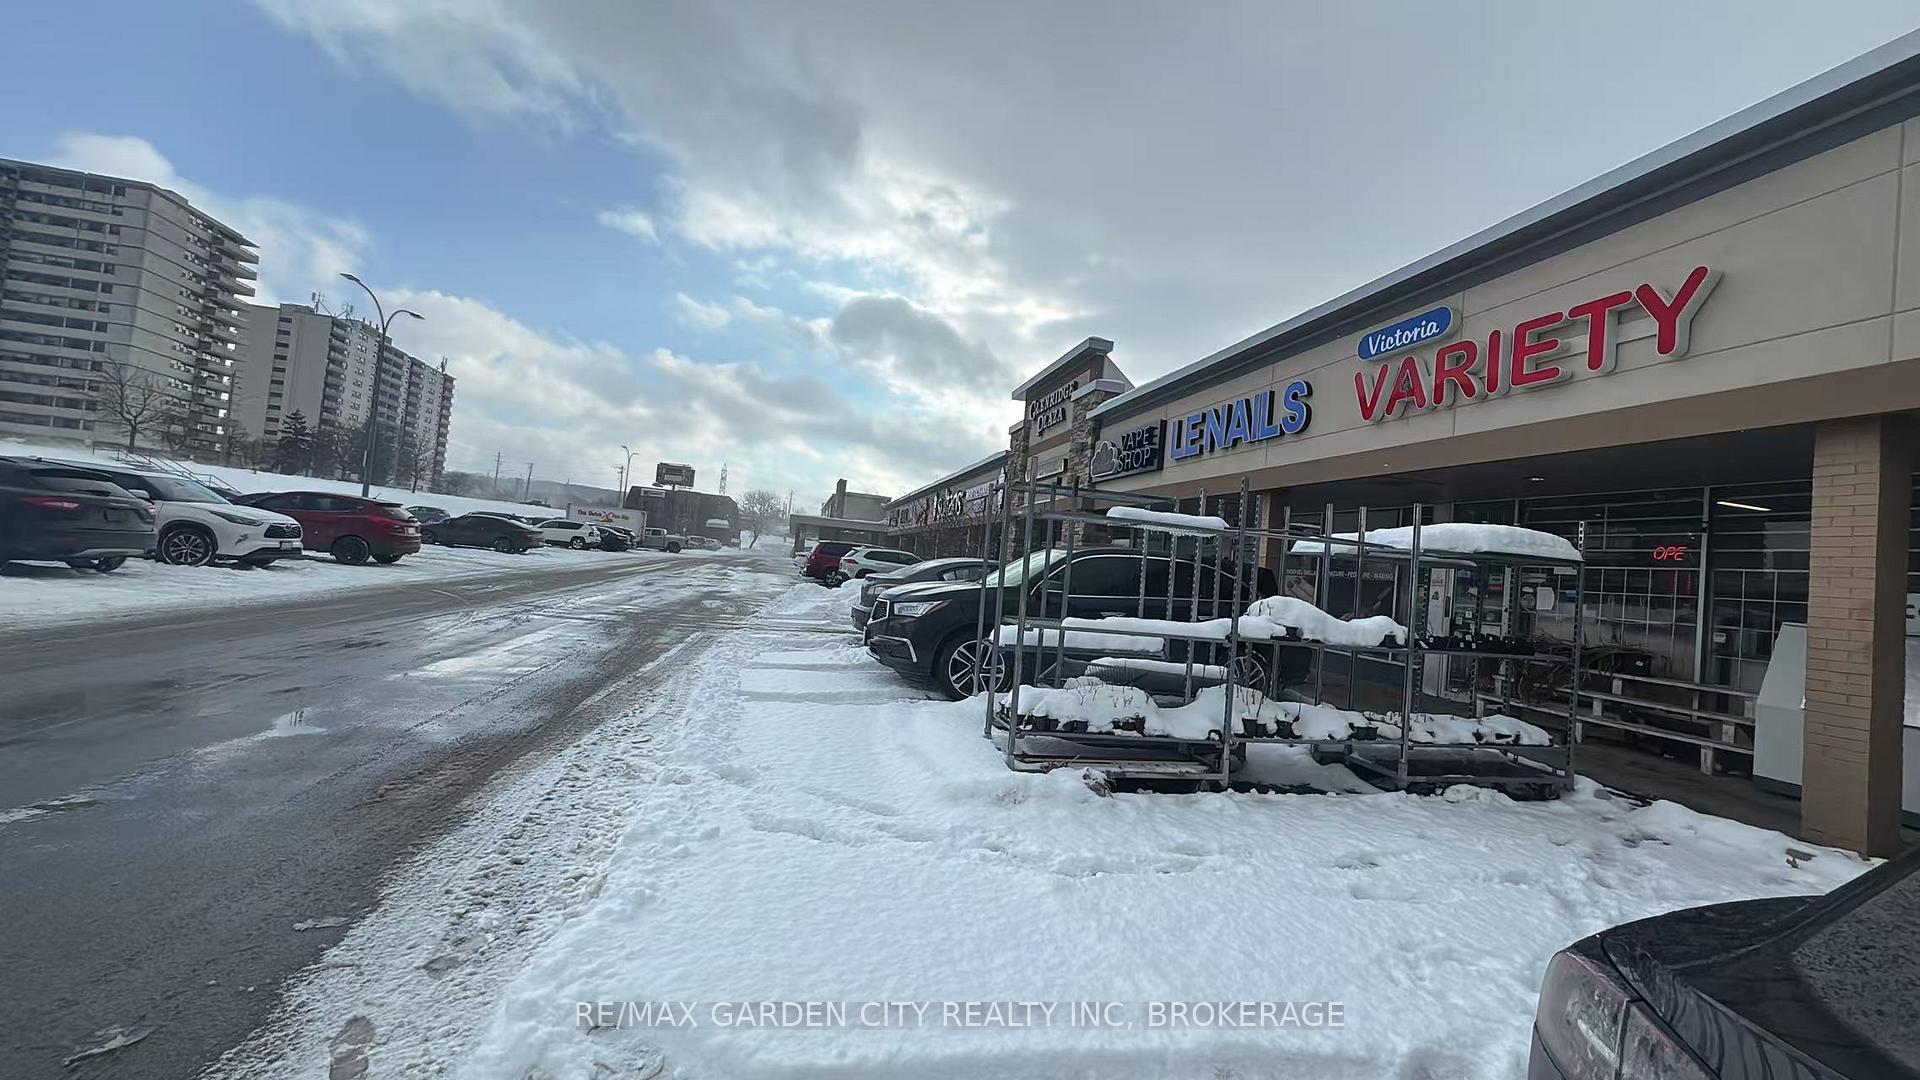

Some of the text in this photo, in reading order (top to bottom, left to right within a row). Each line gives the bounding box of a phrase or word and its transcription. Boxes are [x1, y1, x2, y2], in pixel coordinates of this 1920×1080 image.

[1354, 265, 1712, 421] VARIETY
[1367, 317, 1440, 356] Victoria
[1037, 408, 1065, 434] PLAZA
[1121, 426, 1152, 451] VAPE
[1117, 448, 1151, 472] SHOP
